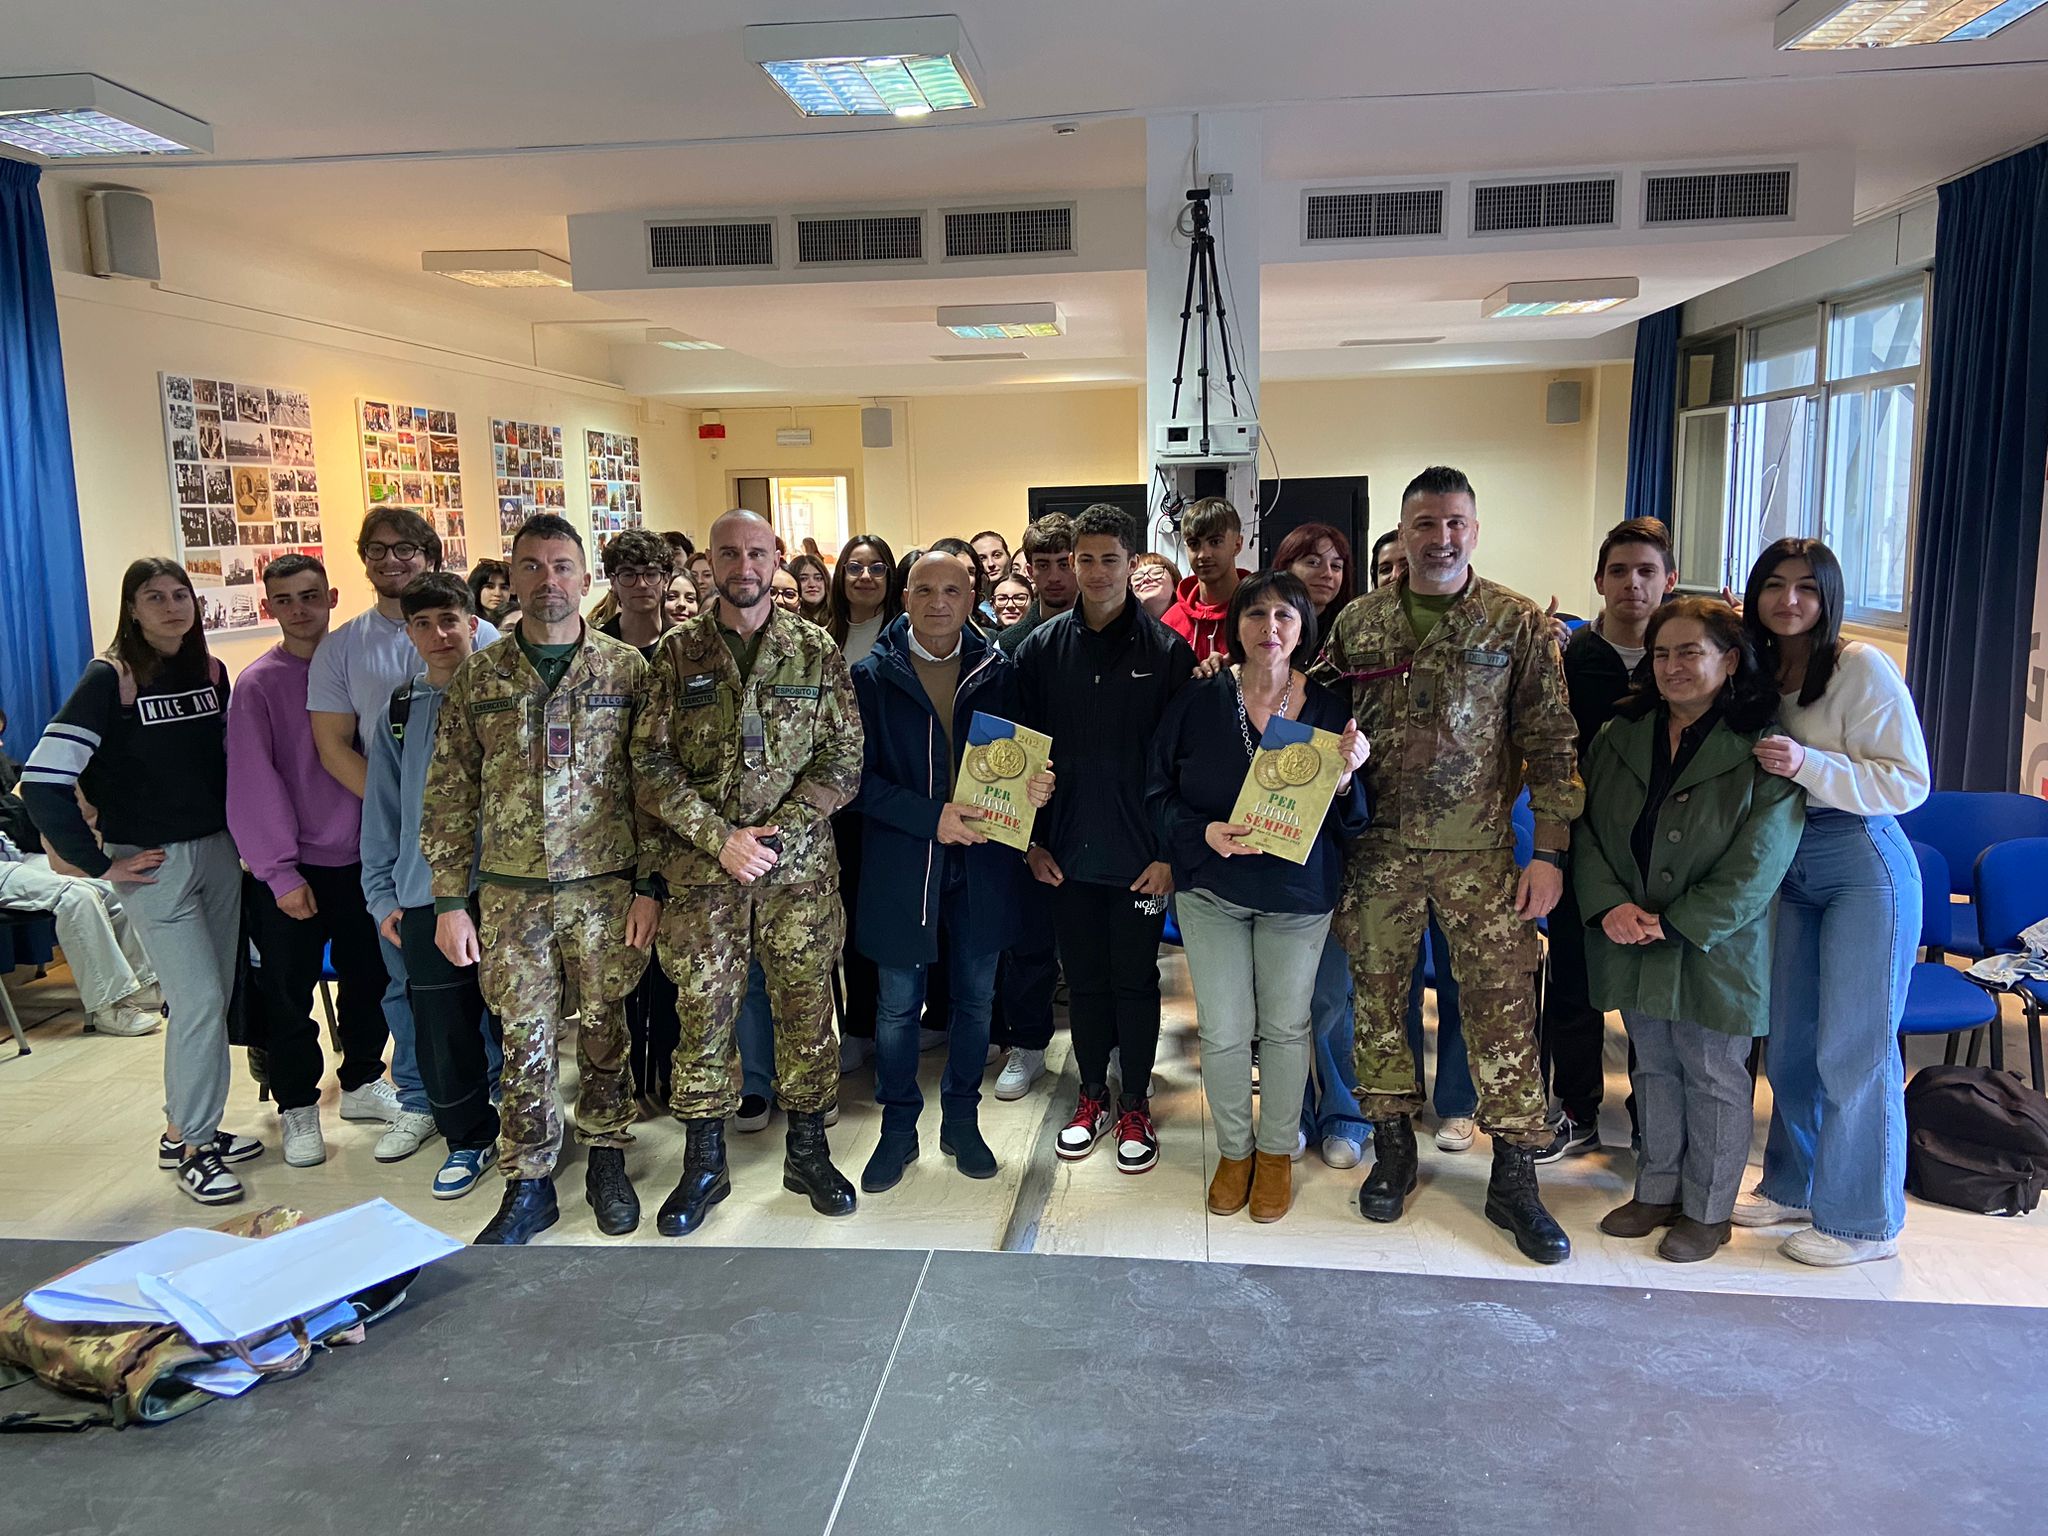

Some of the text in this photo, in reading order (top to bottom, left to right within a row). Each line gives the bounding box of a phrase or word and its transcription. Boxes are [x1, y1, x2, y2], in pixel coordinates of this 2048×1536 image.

[775, 687, 811, 696] ESPOSITO
[145, 692, 217, 720] NIKE AIR
[984, 785, 1010, 802] PER
[1268, 792, 1297, 811] PER
[1243, 812, 1304, 841] SEMPRE
